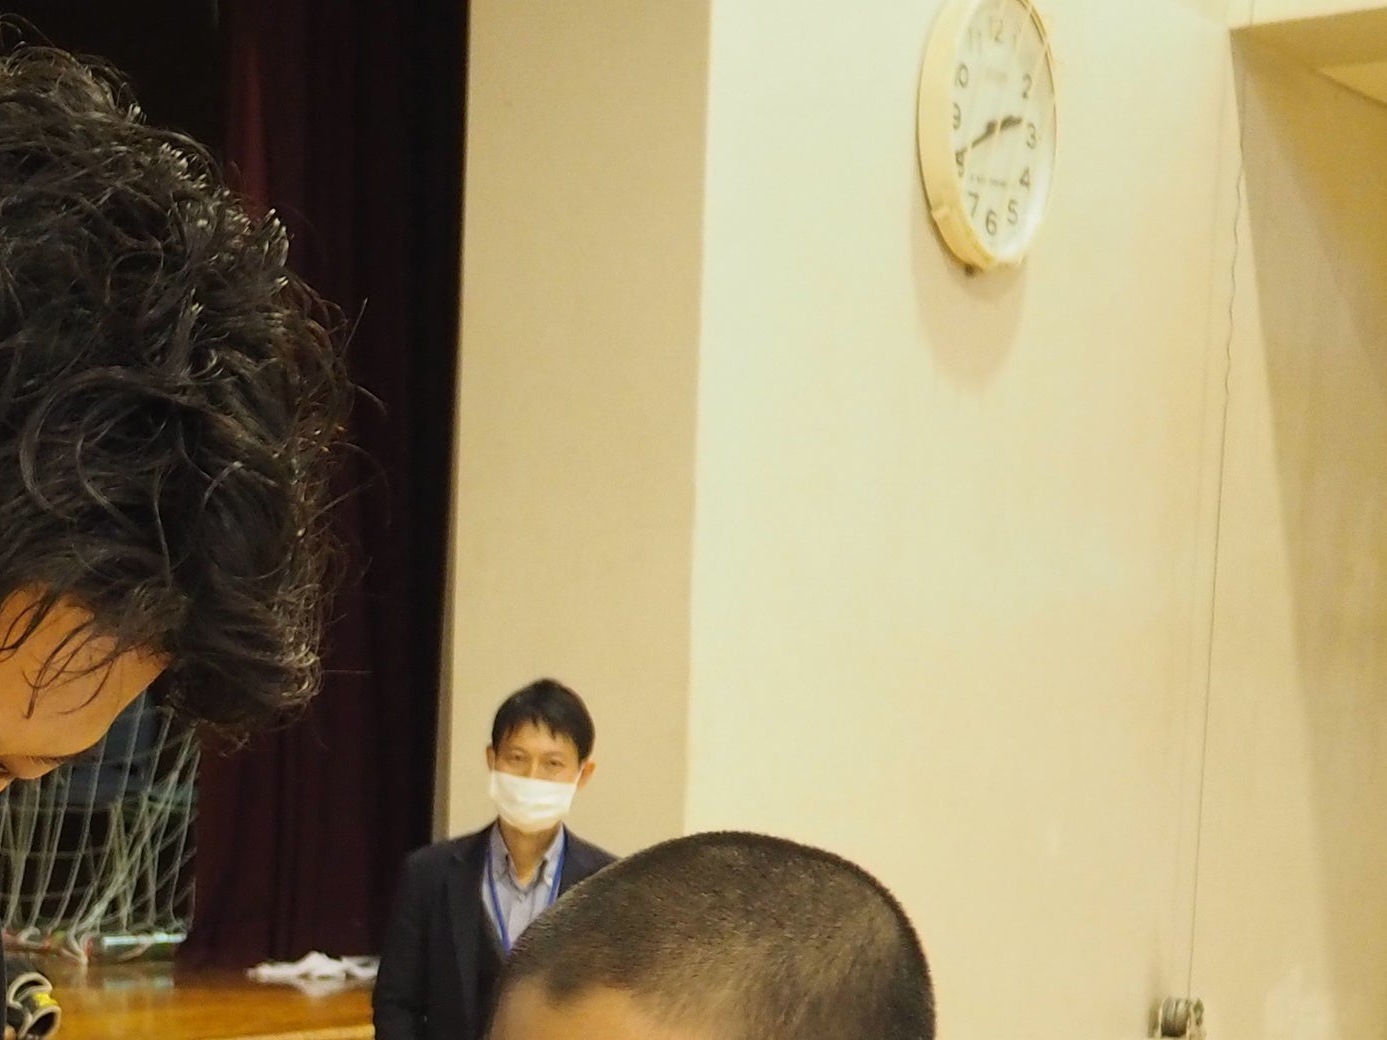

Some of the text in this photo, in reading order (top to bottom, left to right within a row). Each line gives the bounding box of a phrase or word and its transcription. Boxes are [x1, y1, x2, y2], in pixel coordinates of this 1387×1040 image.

[1021, 73, 1033, 99] 2
[1025, 121, 1037, 150] 3
[1019, 166, 1031, 191] 4
[968, 191, 980, 218] 7
[1007, 198, 1019, 225] 5
[985, 209, 998, 236] 6
